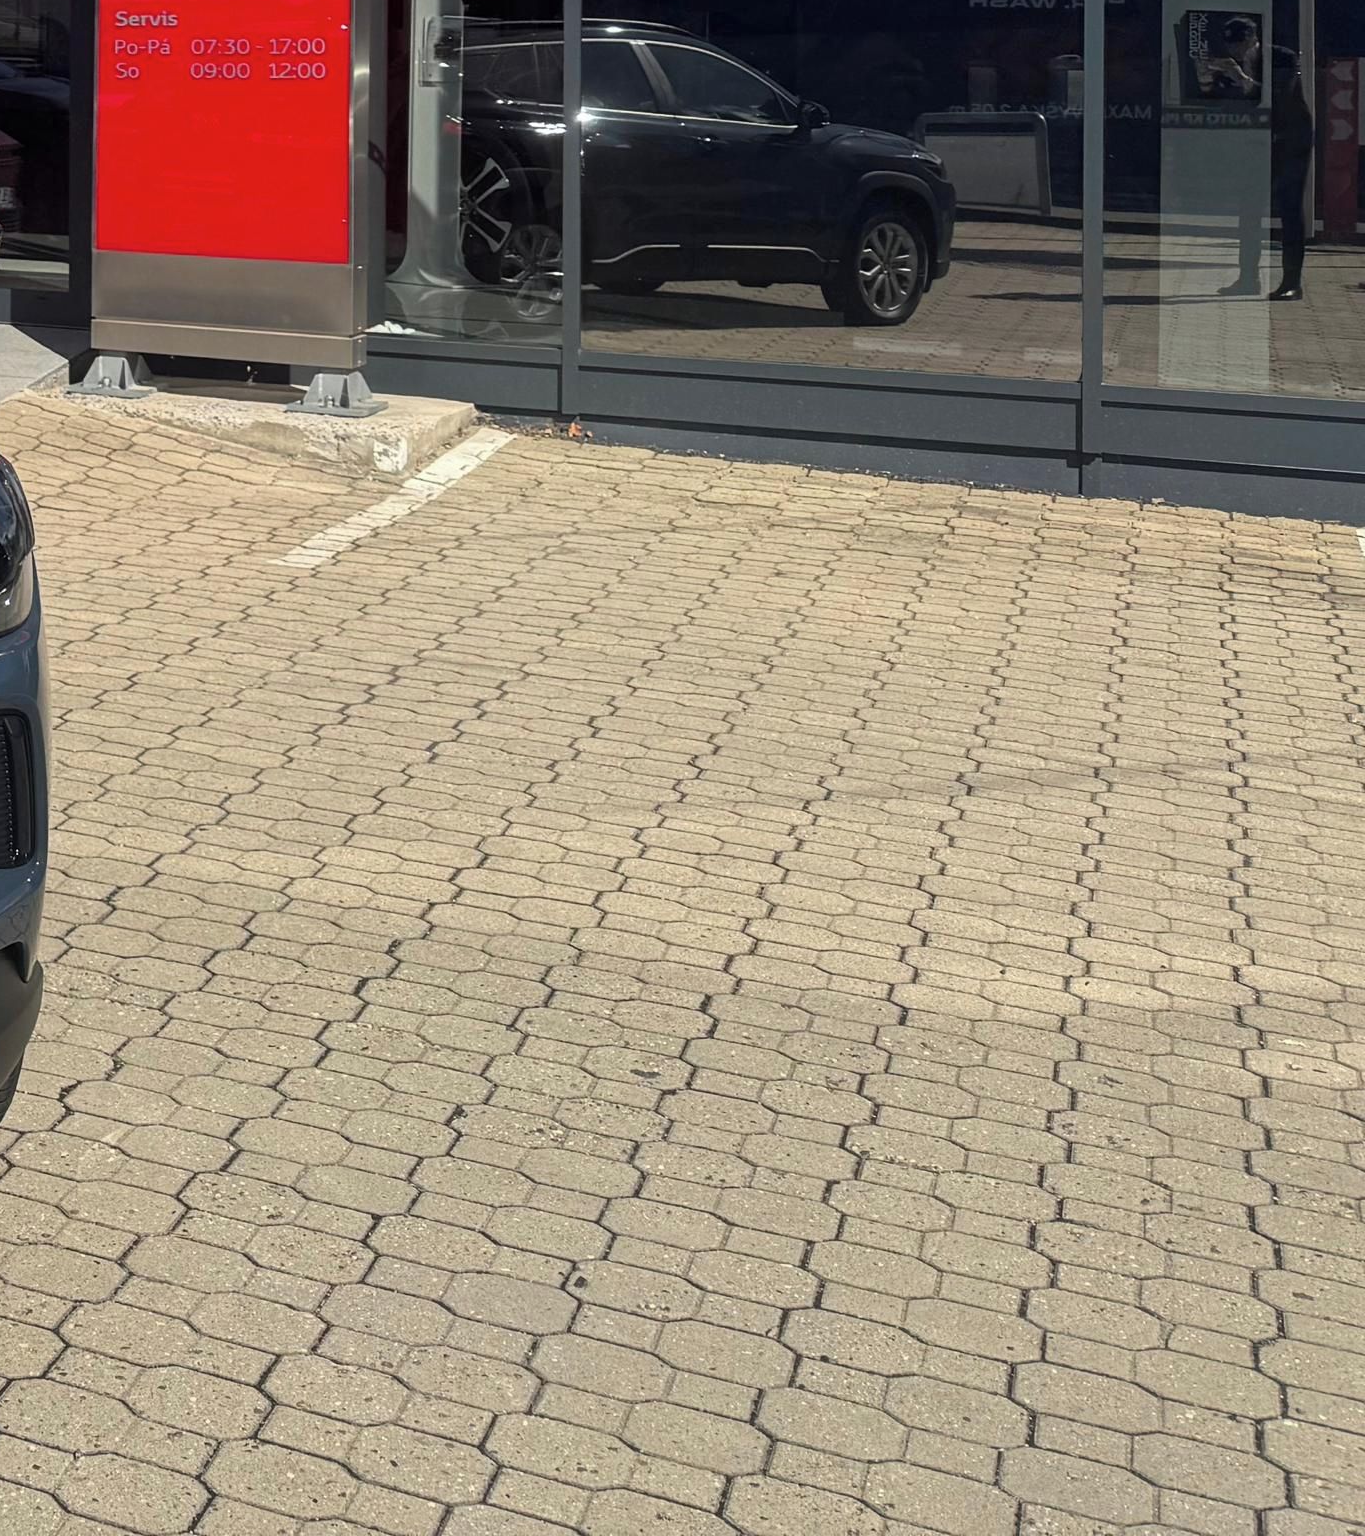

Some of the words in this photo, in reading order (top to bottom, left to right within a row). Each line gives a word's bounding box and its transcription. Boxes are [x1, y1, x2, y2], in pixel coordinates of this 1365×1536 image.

[115, 11, 178, 27] Servis
[114, 38, 171, 55] Po-Pá
[191, 39, 250, 55] 07:30
[269, 38, 326, 55] 17:00
[115, 63, 139, 79] So
[190, 63, 250, 79] 09:00
[269, 62, 326, 79] 12:00
